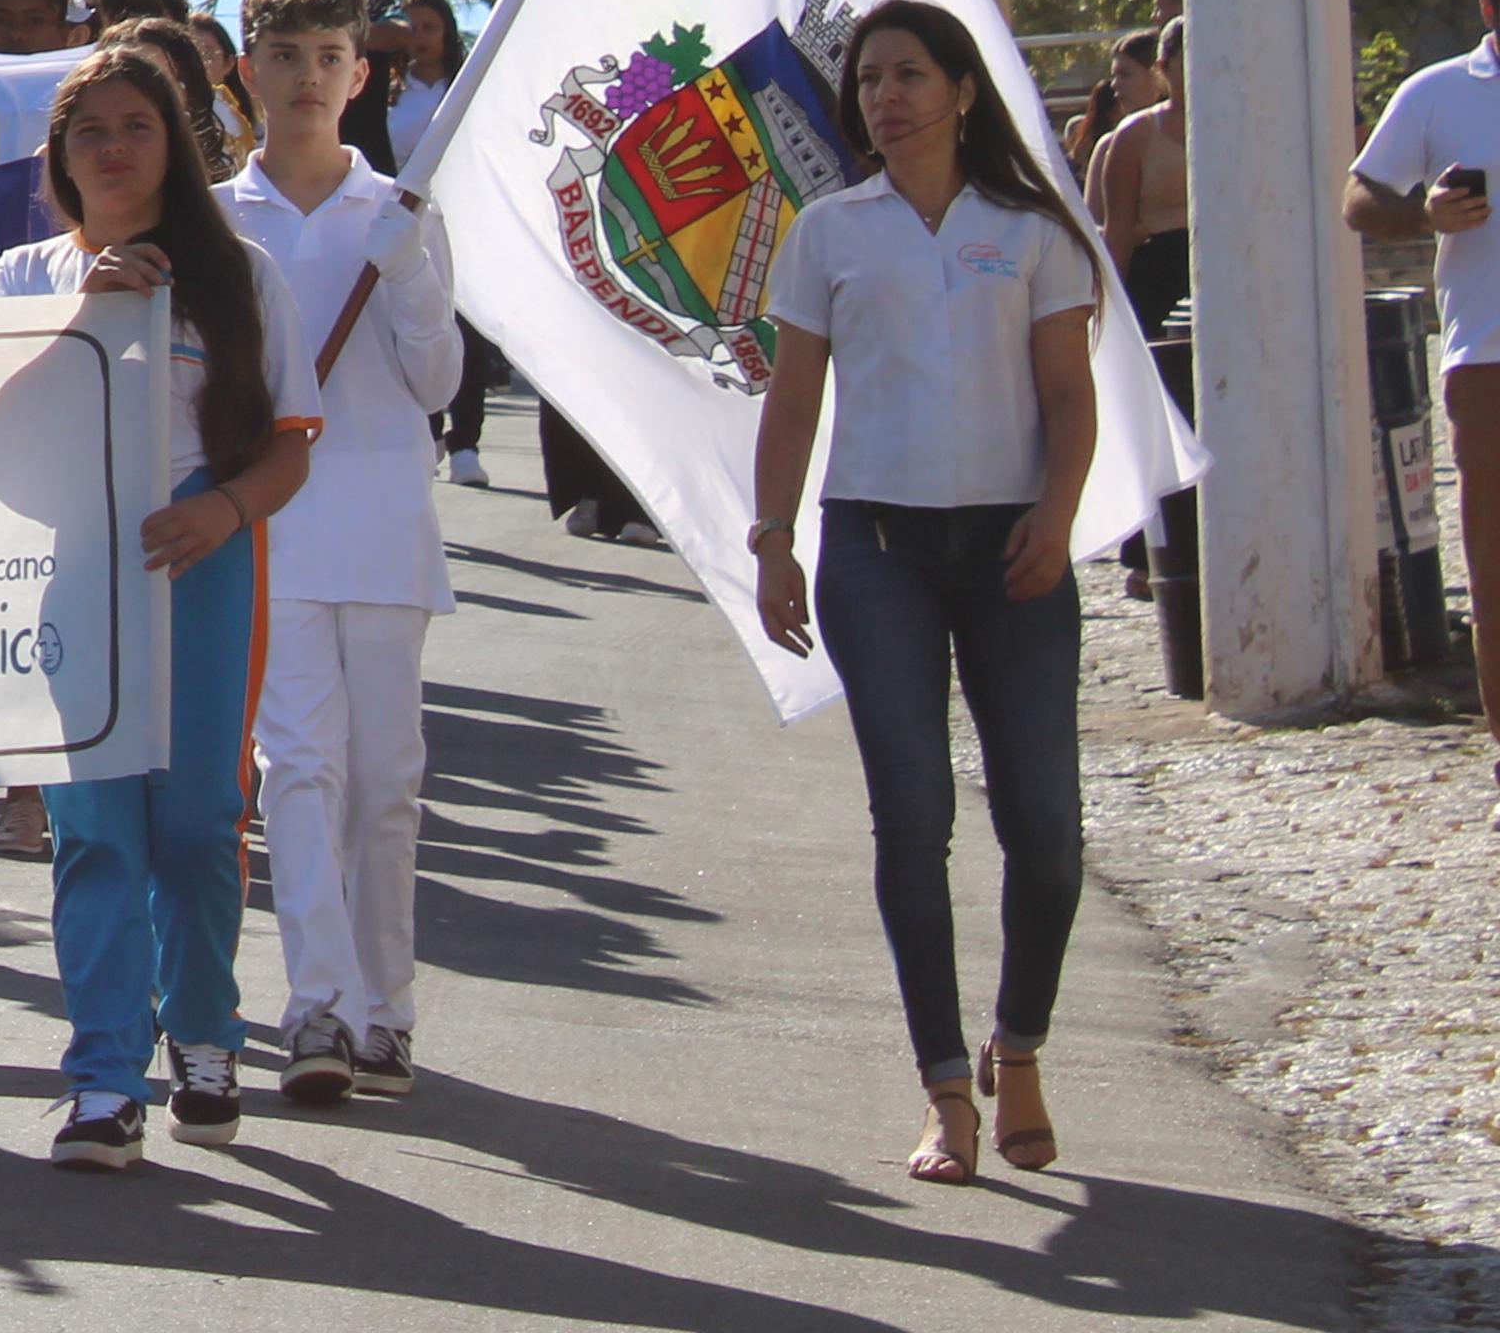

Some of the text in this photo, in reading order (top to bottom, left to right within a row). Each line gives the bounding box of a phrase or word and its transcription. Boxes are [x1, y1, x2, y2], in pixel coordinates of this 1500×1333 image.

[562, 92, 616, 140] 1692
[555, 178, 685, 349] BAEPENDI
[729, 333, 771, 382] 1856
